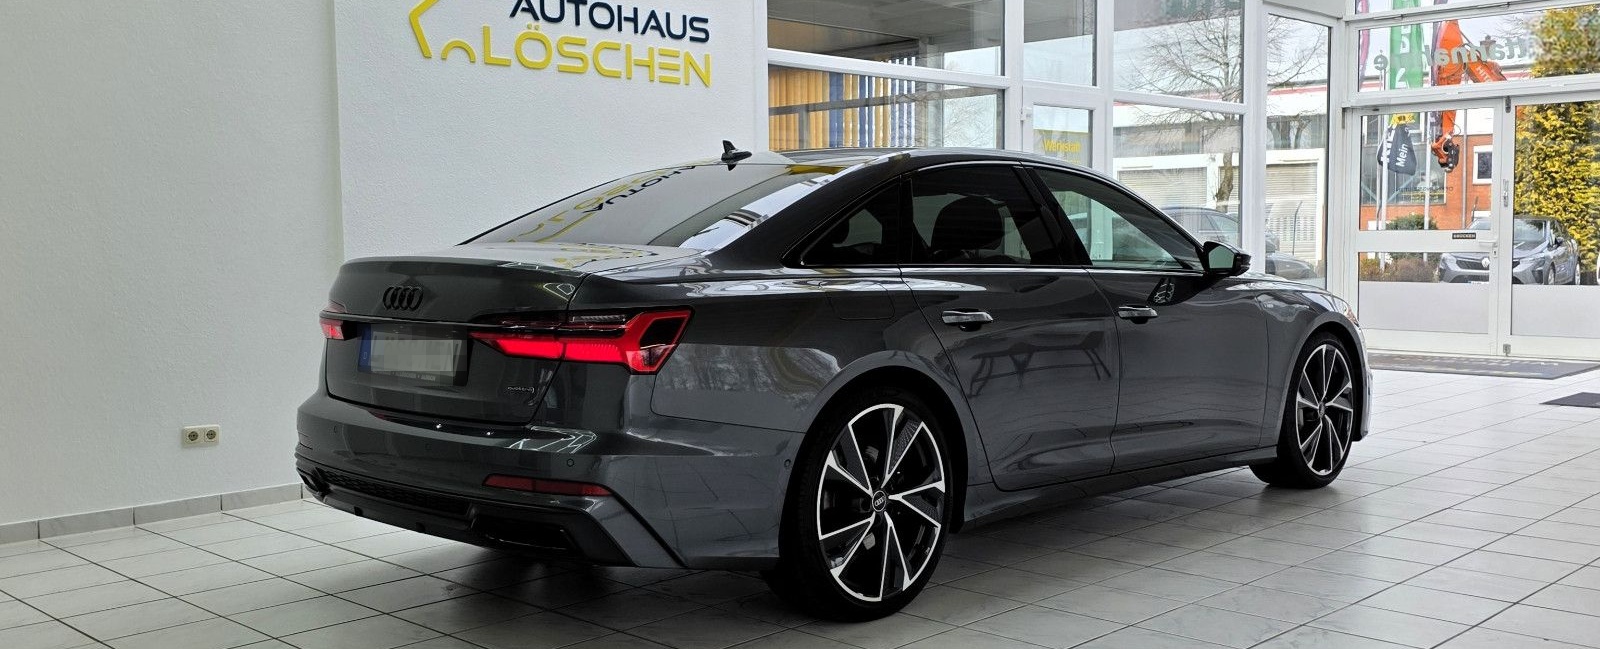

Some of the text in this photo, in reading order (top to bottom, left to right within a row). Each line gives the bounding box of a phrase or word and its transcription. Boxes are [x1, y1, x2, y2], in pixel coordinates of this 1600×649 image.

[510, 0, 710, 43] AUTOHAUS
[483, 23, 712, 87] LÖSCHEN
[1396, 143, 1408, 167] Mein
